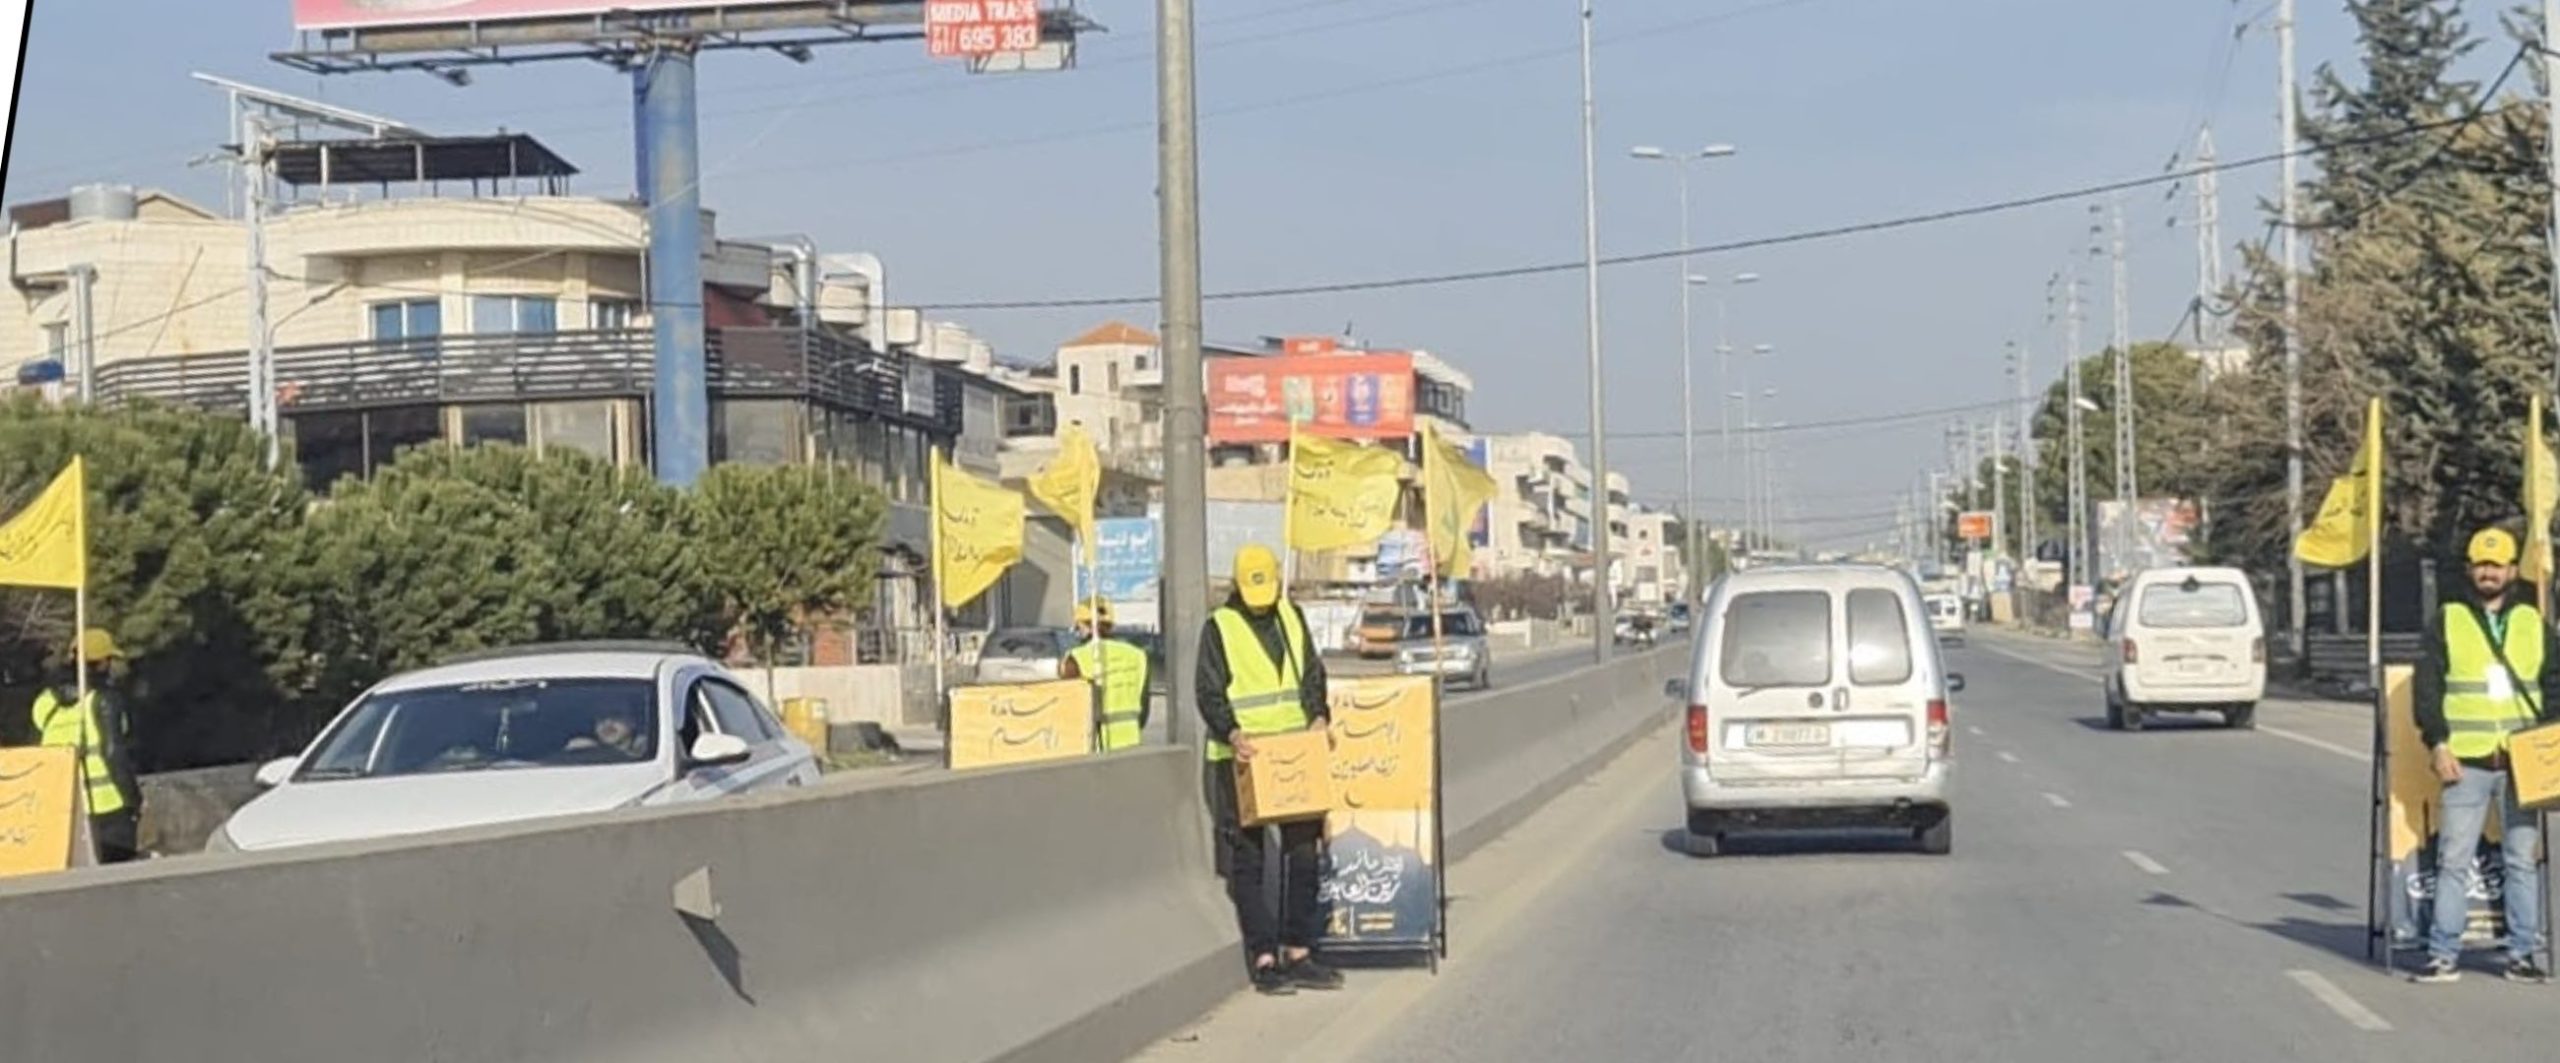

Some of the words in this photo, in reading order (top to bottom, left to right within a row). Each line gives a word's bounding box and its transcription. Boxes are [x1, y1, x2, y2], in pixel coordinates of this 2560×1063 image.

[930, 3, 981, 23] MEDIA
[960, 26, 995, 50] 695
[1001, 25, 1037, 49] 383
